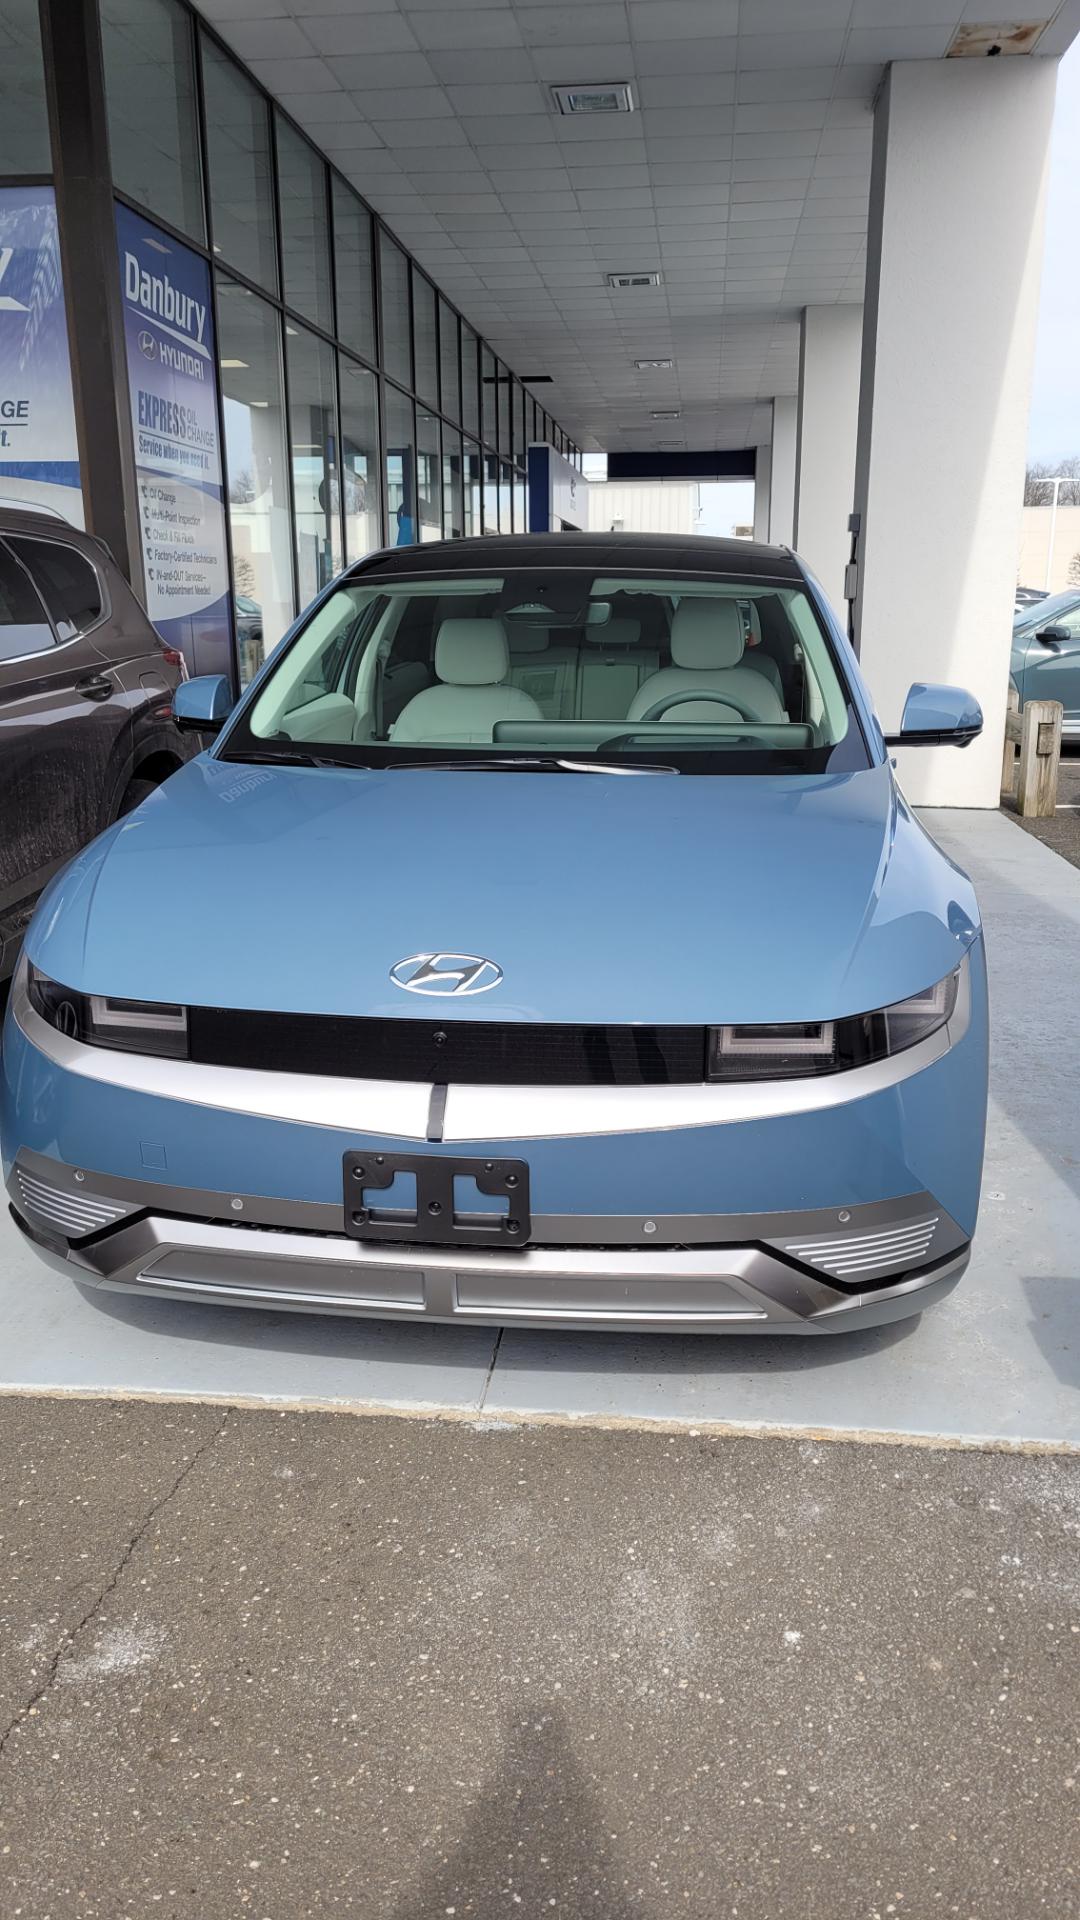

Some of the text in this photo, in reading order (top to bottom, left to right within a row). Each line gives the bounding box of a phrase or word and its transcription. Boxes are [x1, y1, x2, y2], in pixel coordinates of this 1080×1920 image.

[125, 251, 206, 343] Danbury
[159, 342, 204, 380] HYUNDAI
[138, 390, 186, 438] EXPRESS
[186, 407, 198, 426] OIL
[186, 425, 215, 447] CHANGE
[138, 434, 163, 459] Service
[163, 443, 179, 462] when
[179, 449, 190, 465] you
[149, 486, 157, 499] Oil
[154, 548, 193, 564] Factory-Certified
[157, 583, 165, 596] No
[165, 584, 194, 598] Appointment
